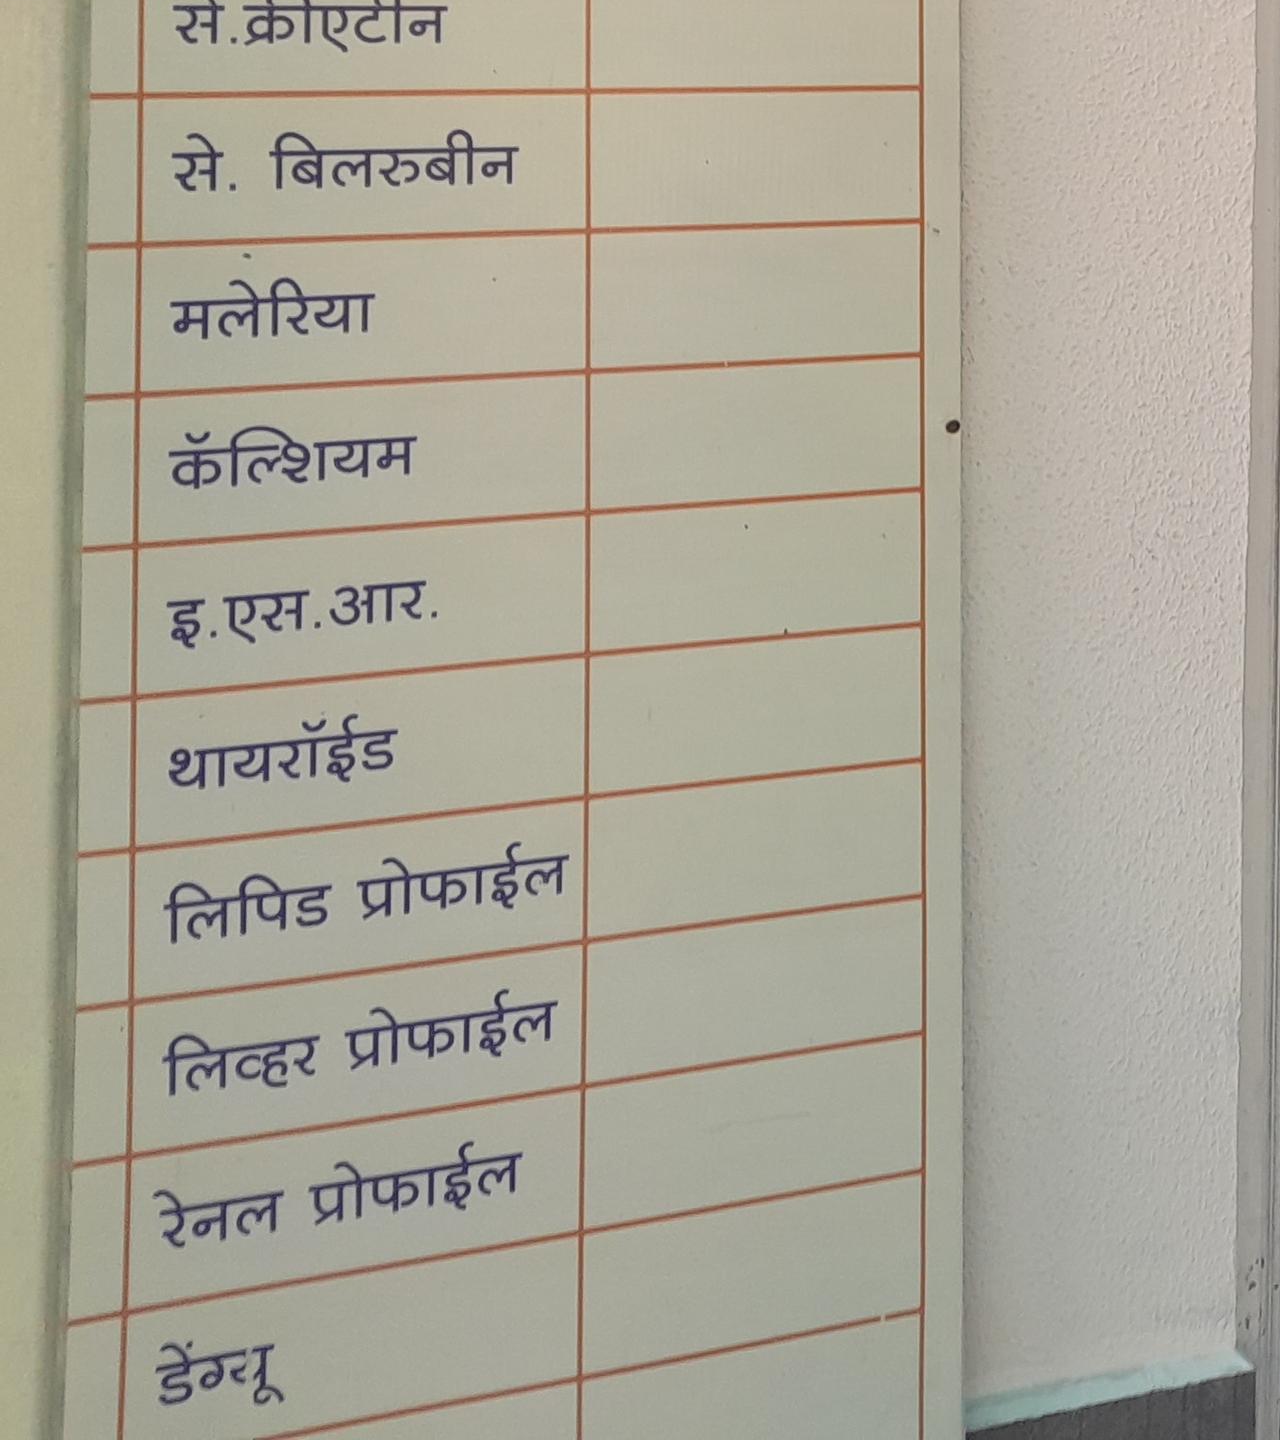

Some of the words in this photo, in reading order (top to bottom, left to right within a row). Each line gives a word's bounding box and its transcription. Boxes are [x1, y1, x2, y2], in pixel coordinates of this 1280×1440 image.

[170, 277, 375, 339] मलेरिया
[168, 426, 417, 489] कॅल्शियम
[168, 713, 398, 789] थायरॉईड
[163, 873, 332, 944] लिपिड
[356, 841, 569, 920] प्रोफाईल
[162, 1033, 320, 1096] लिव्हर
[344, 989, 558, 1070] प्रोफाईल
[153, 1189, 284, 1248] रेनल
[308, 1141, 523, 1225] प्रोफाईल
